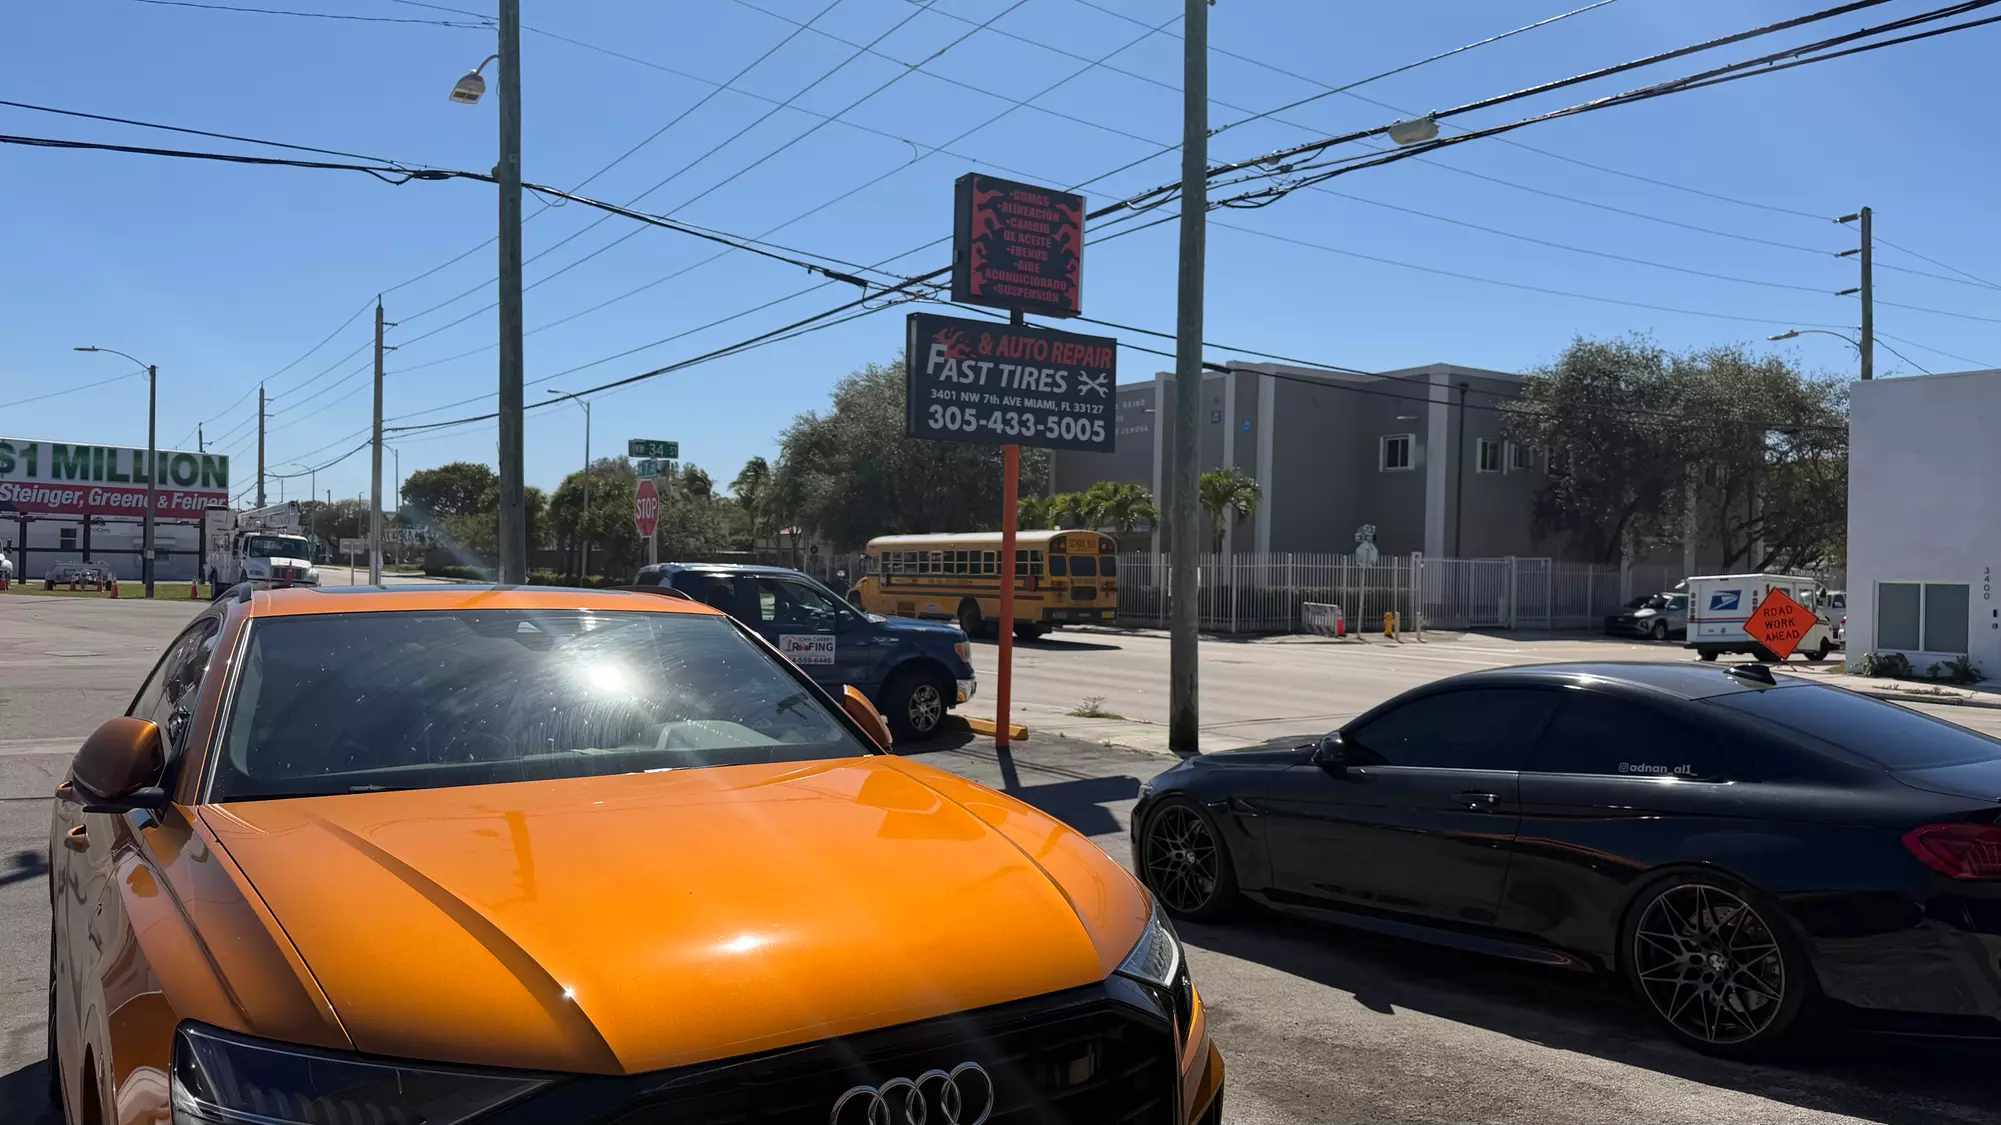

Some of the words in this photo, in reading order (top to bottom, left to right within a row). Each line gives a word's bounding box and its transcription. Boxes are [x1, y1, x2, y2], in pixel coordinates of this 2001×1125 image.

[1010, 217, 1050, 234] CAMBIO
[1003, 229, 1016, 242] DE
[1018, 232, 1053, 248] ACEITE
[1011, 245, 1049, 261] FRENOS
[1017, 260, 1040, 273] AIRE
[985, 268, 1067, 291] ACONDICIONADO
[978, 332, 993, 356] &
[996, 335, 1048, 361] AUTO
[1051, 341, 1112, 368] REPAIR
[926, 343, 994, 386] FAST
[999, 364, 1068, 394] TIRES
[930, 389, 956, 401] 3401
[961, 391, 980, 403] NW
[983, 393, 1000, 405] 7th
[1002, 396, 1022, 407] AVE
[1024, 398, 1058, 412] MIAMI,
[1061, 402, 1071, 412] FL
[1074, 403, 1104, 414] 33127
[928, 404, 1106, 443] 305-433-5005
[648, 443, 664, 456] 34
[52, 443, 227, 488] MILLION
[0, 482, 84, 508] Steinger,
[157, 495, 168, 509] &
[636, 497, 657, 520] STOP
[1764, 605, 1793, 617] ROAD
[1765, 617, 1795, 629] WORK
[1765, 630, 1800, 642] AHEAD
